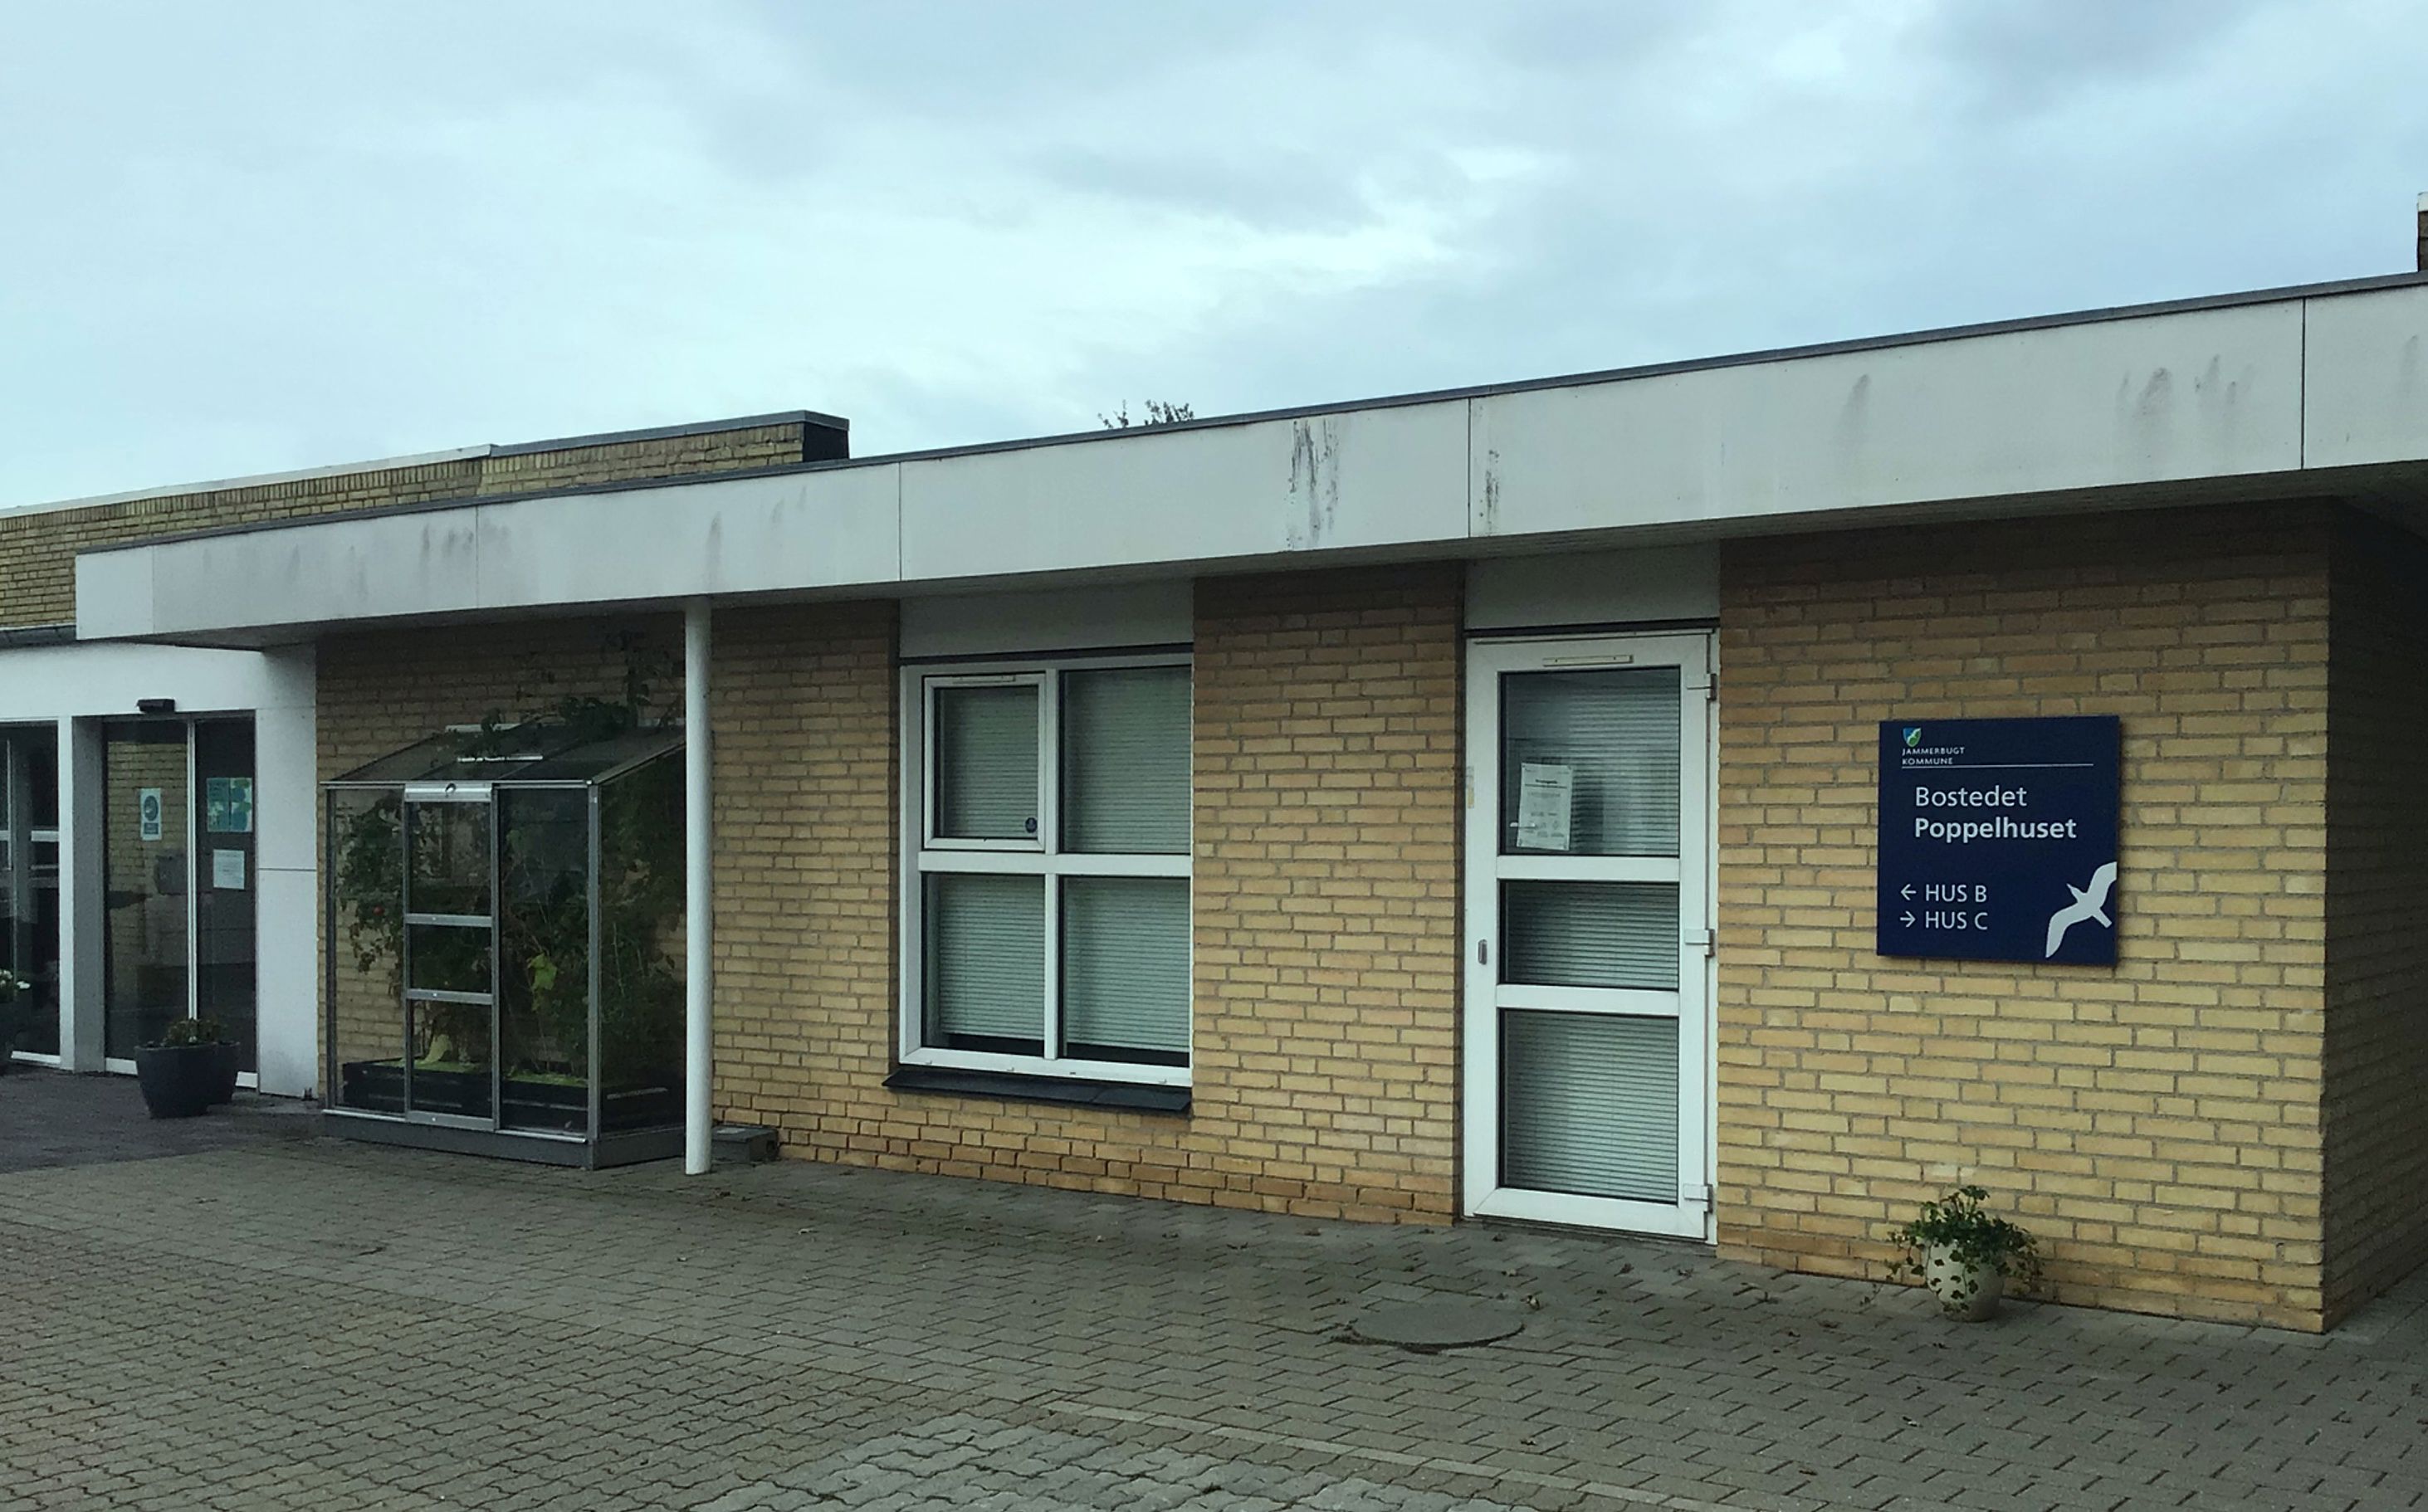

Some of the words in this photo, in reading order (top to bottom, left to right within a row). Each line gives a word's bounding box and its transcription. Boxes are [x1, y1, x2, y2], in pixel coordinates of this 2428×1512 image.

[1902, 747, 1966, 756] JAMMERBUGT
[1902, 757, 1953, 765] KOMMUNE
[1915, 785, 2027, 807] Bostedet
[1914, 817, 2077, 843] Poppelhuset
[1925, 884, 1967, 902] HUS
[1975, 885, 1987, 902] B
[1925, 911, 1967, 929] HUS
[1974, 912, 1988, 929] C
